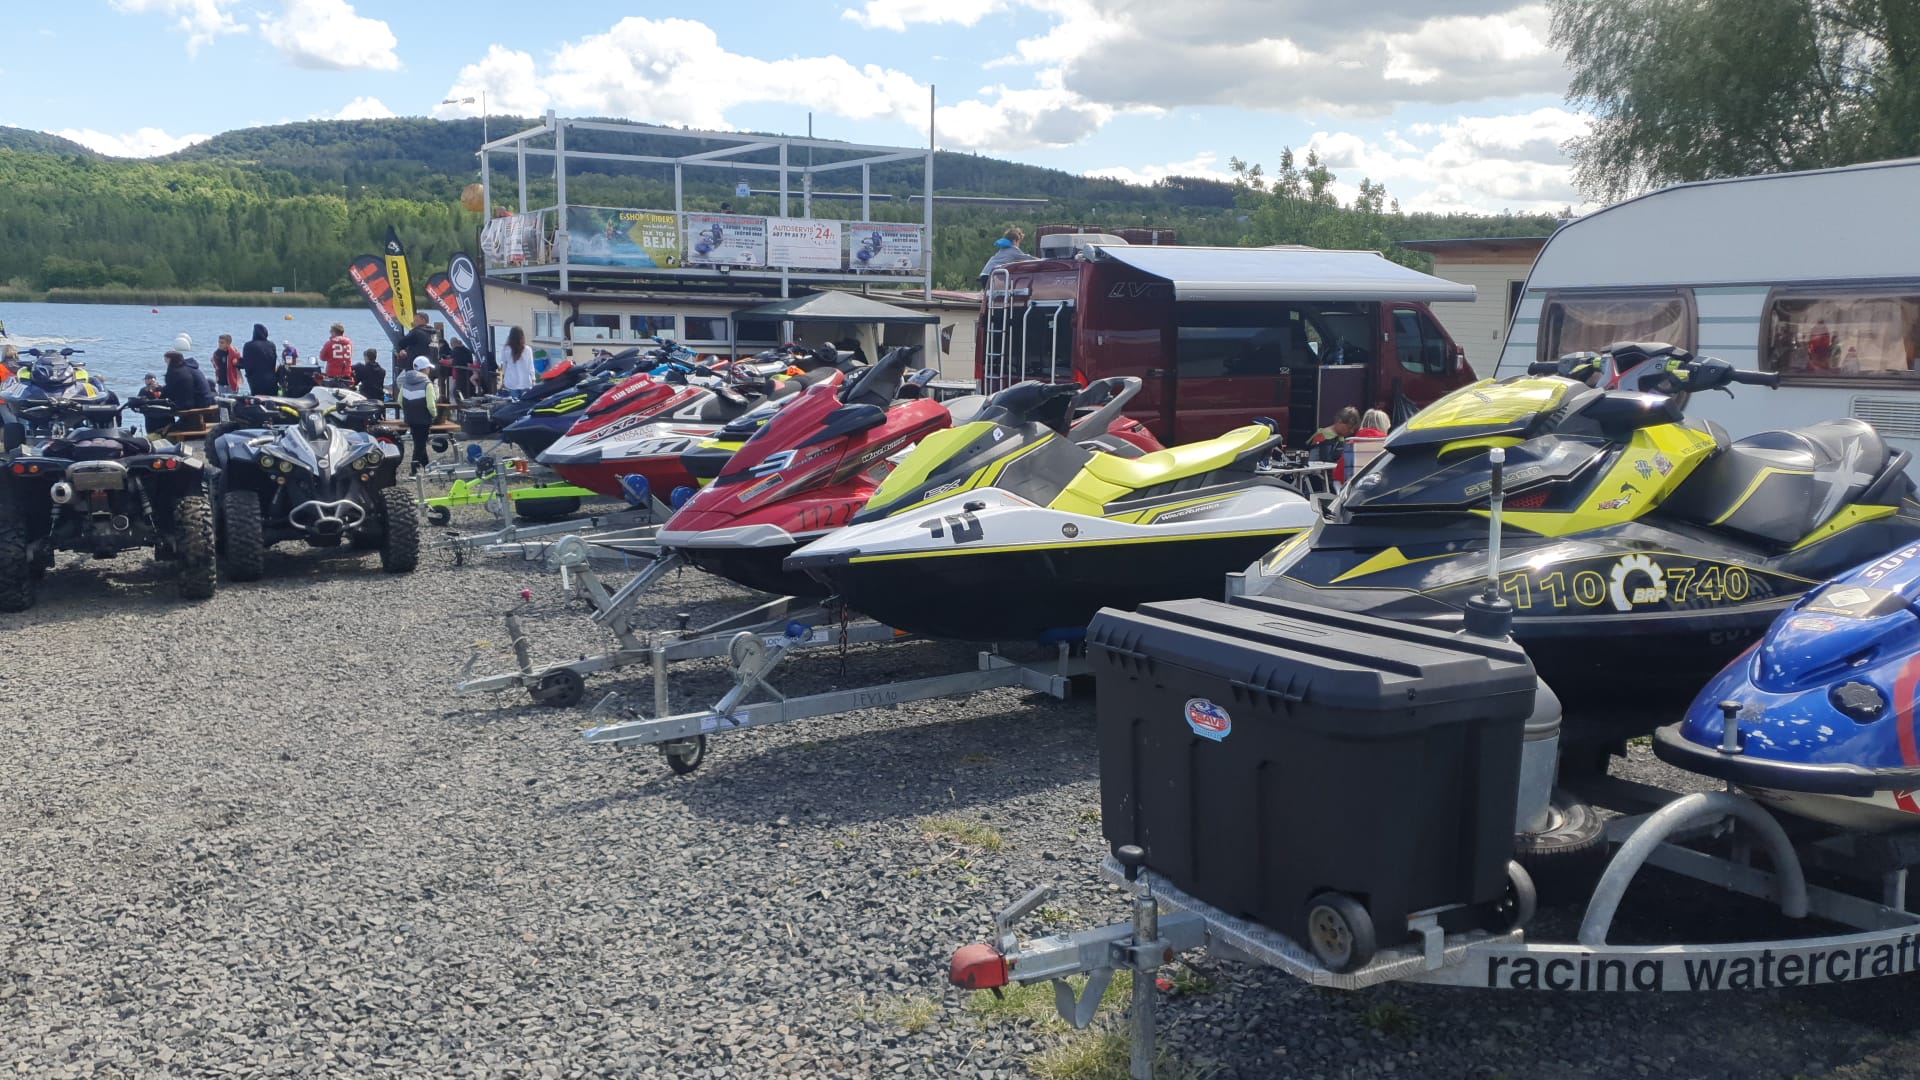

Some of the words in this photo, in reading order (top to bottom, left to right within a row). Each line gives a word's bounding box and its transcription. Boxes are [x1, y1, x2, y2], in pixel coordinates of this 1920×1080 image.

[773, 225, 814, 233] AUTOSERVIS
[643, 236, 676, 249] BEJK
[332, 343, 352, 359] 23
[798, 504, 835, 529] 112
[1866, 544, 1920, 580] SUP
[1504, 570, 1607, 609] 110
[1667, 566, 1749, 603] 740
[1632, 586, 1668, 604] BRP
[1488, 951, 1664, 991] racing
